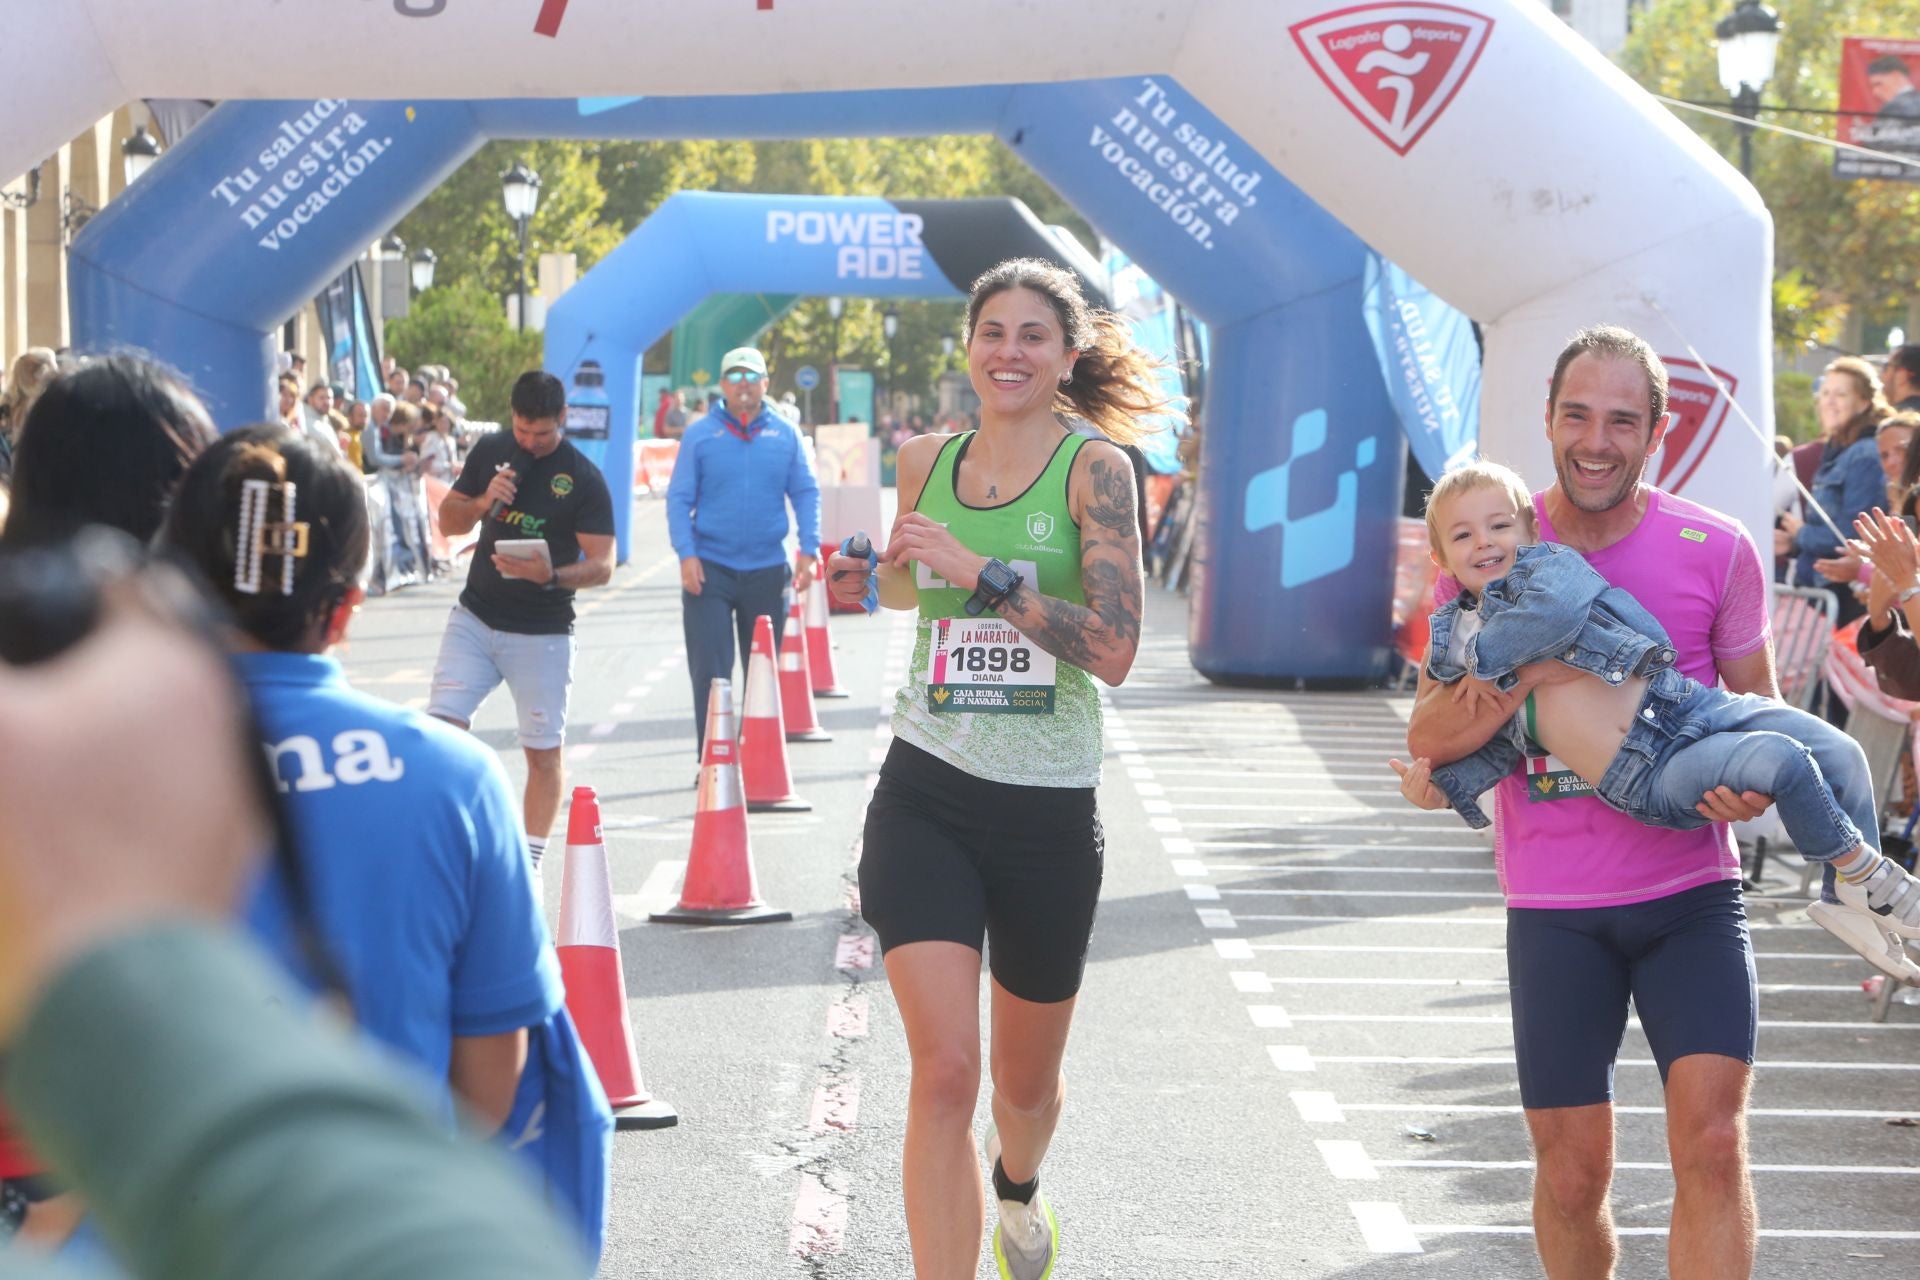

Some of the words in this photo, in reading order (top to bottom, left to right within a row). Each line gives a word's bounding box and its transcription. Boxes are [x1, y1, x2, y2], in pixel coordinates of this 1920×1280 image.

[1329, 31, 1380, 51] Logroño
[1413, 27, 1462, 42] deporte
[1135, 77, 1177, 127] Tu
[1173, 122, 1262, 207] salud,
[240, 112, 367, 230] nuestra
[1111, 107, 1239, 226] nuestra
[210, 167, 261, 207] Tu
[258, 137, 393, 251] vocación.
[1089, 125, 1214, 250] vocación.
[766, 210, 924, 246] POWER
[837, 246, 924, 279] ADE
[961, 631, 972, 643] LA
[974, 627, 1020, 644] MARATÓN
[950, 647, 1030, 673] 1898
[971, 673, 1004, 682] DIANA
[953, 689, 974, 697] CAJA
[976, 690, 1006, 698] RURAL
[953, 697, 967, 705] DE
[968, 697, 1010, 706] NAVARRA
[1013, 690, 1047, 698] ACCIÓN
[1013, 699, 1045, 707] SOCIAL
[1558, 776, 1579, 784] CAJA
[1558, 784, 1571, 793] DE
